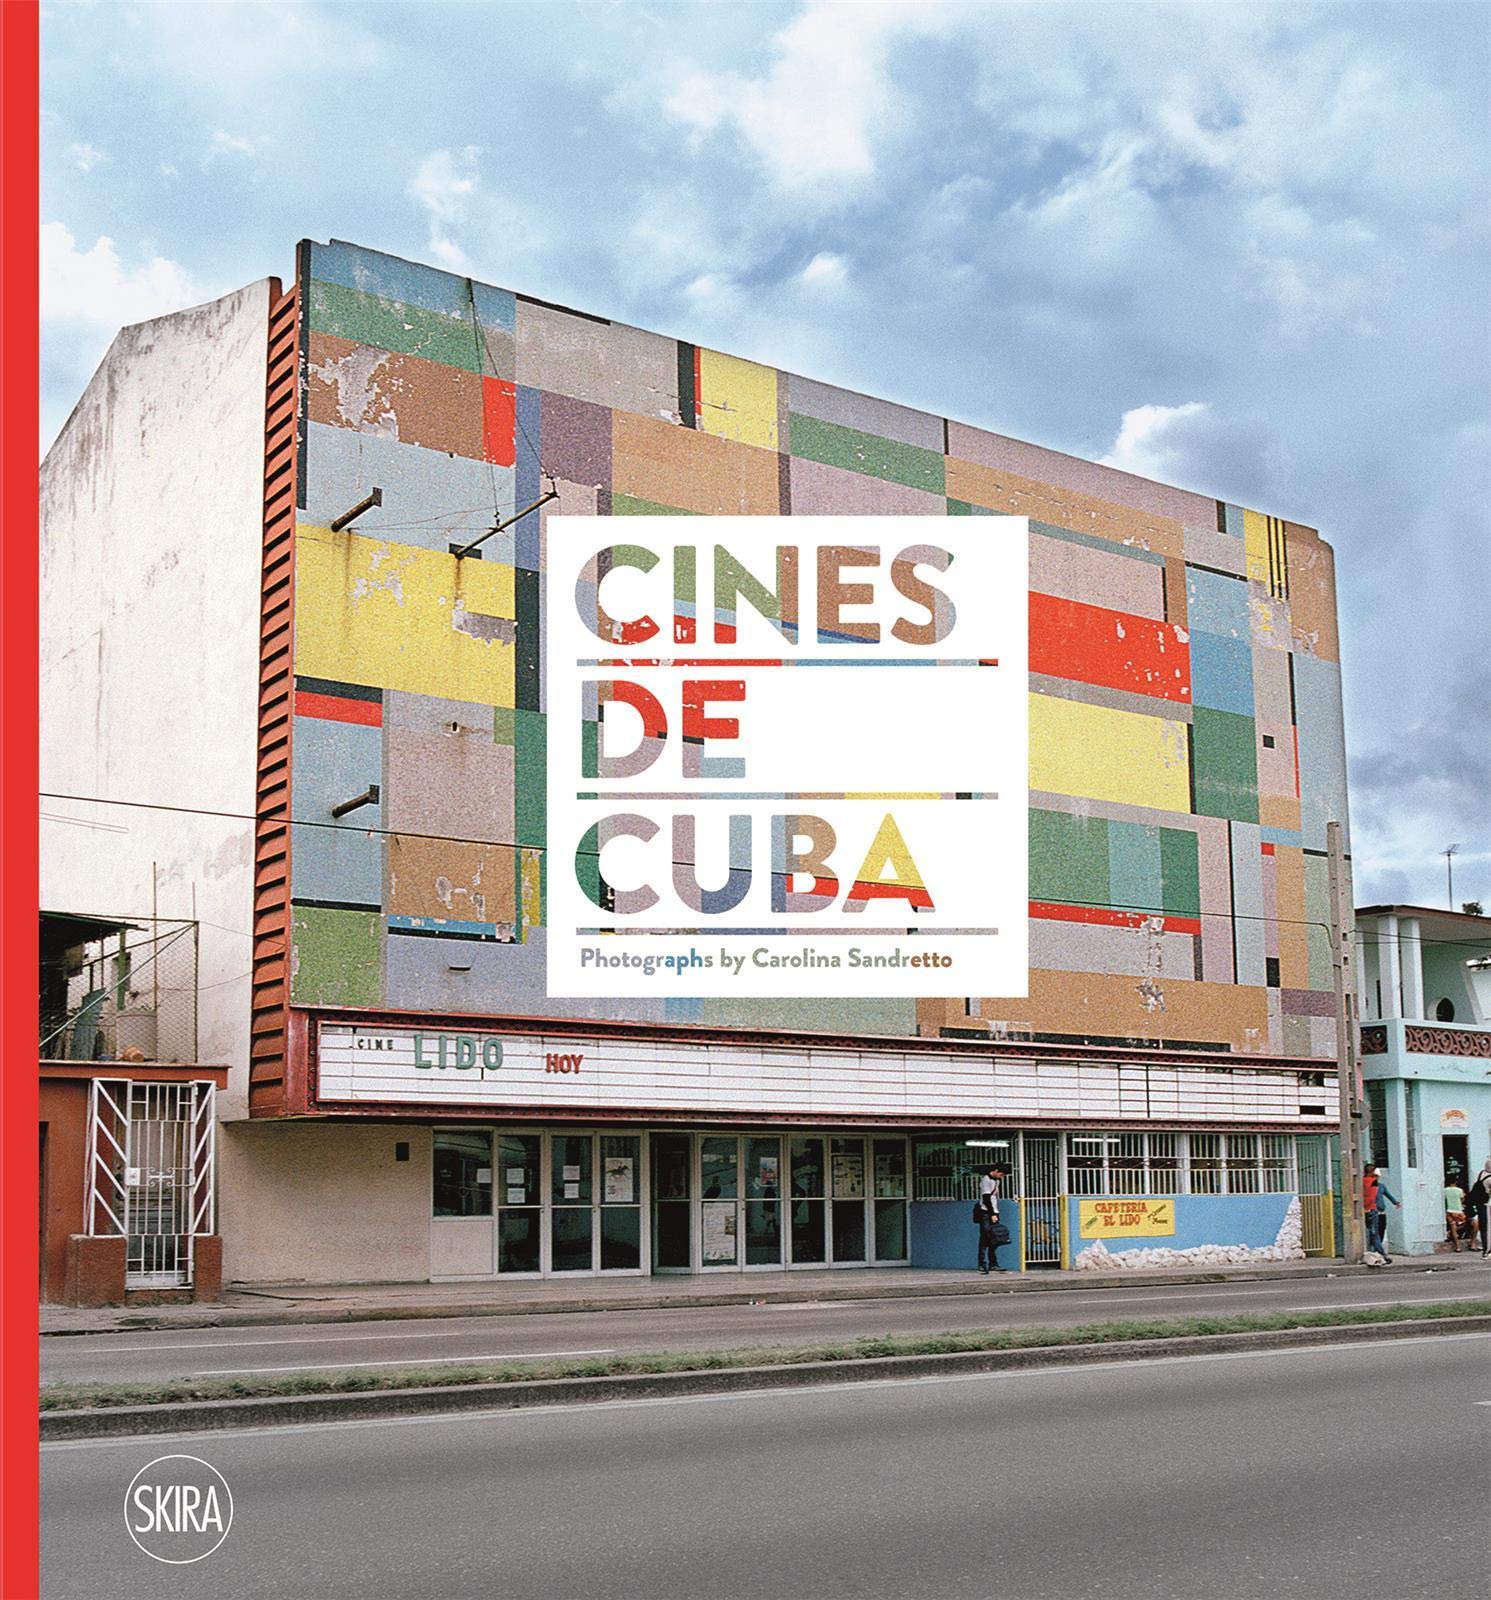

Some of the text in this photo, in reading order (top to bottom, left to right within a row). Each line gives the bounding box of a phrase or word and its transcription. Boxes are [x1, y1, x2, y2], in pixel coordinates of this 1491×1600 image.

[357, 1034, 584, 1074] CINE LIDO HOY
[1103, 1214, 1116, 1226] EL
[1119, 1214, 1141, 1226] LIDO
